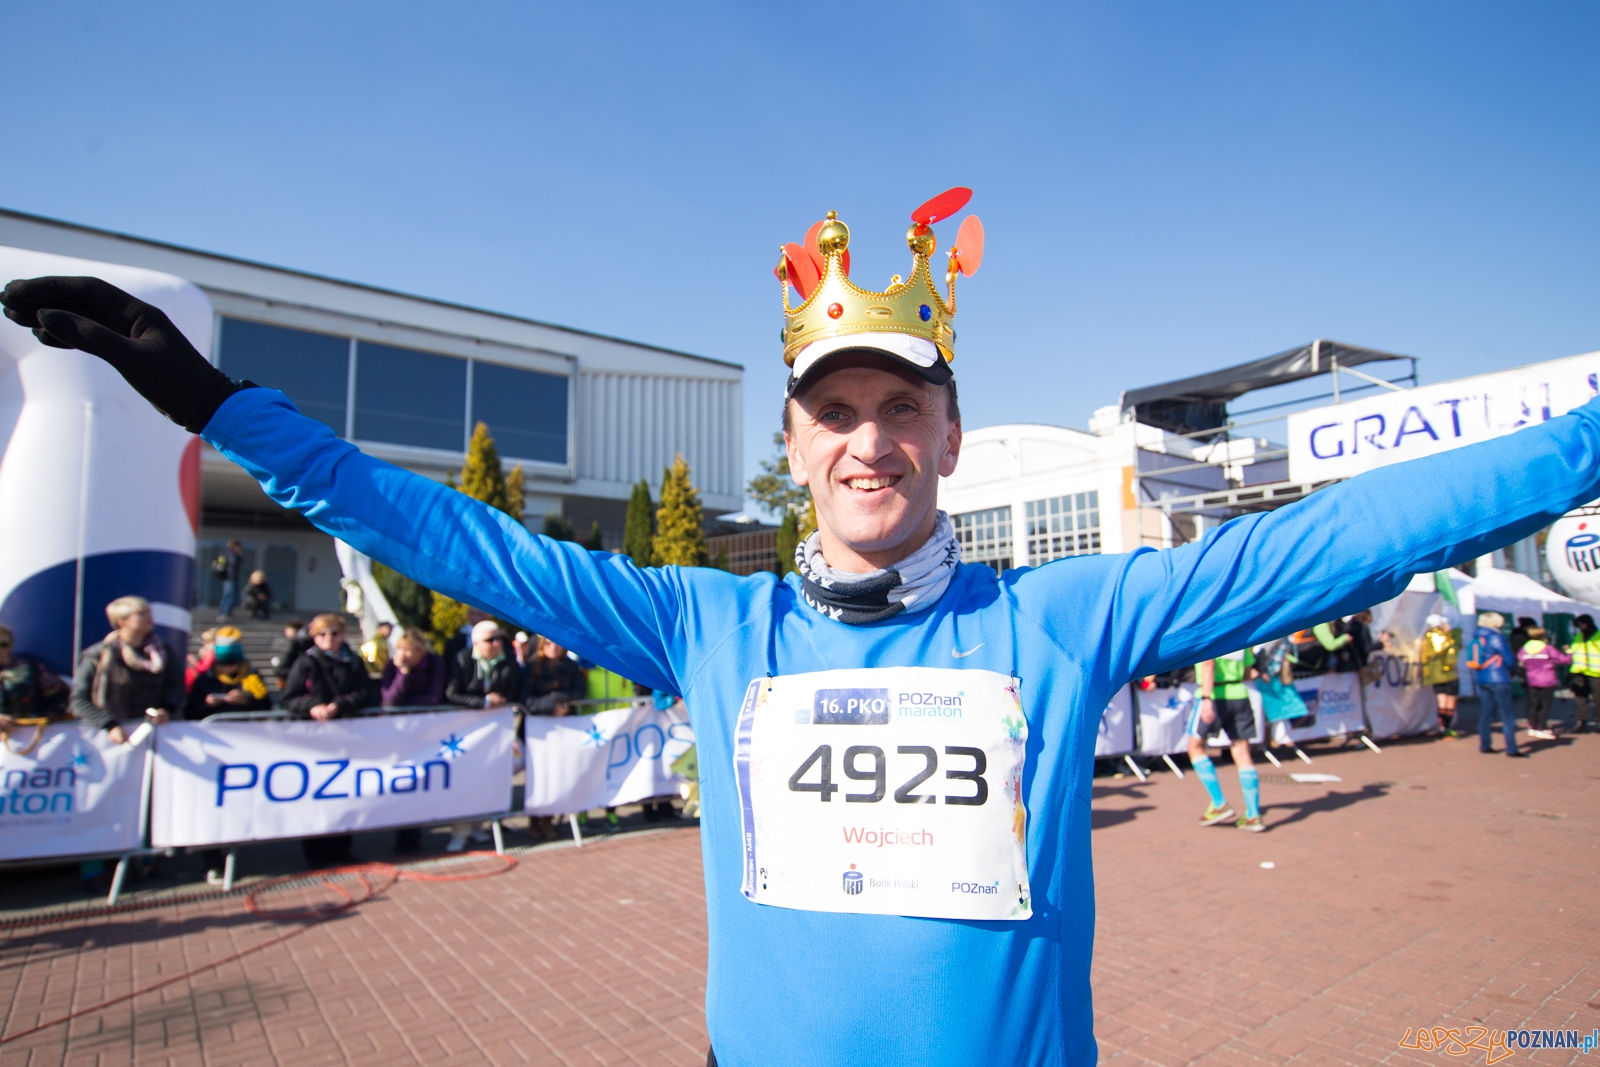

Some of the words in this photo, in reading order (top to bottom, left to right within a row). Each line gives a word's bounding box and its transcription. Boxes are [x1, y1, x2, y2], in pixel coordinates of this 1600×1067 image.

[820, 698, 843, 714] 16.
[847, 698, 885, 714] PKO
[899, 705, 963, 718] maraton
[0, 766, 77, 789] nan
[788, 743, 989, 807] 4923
[843, 826, 934, 848] Wojciech
[869, 877, 892, 889] Bank
[894, 878, 919, 890] Polski
